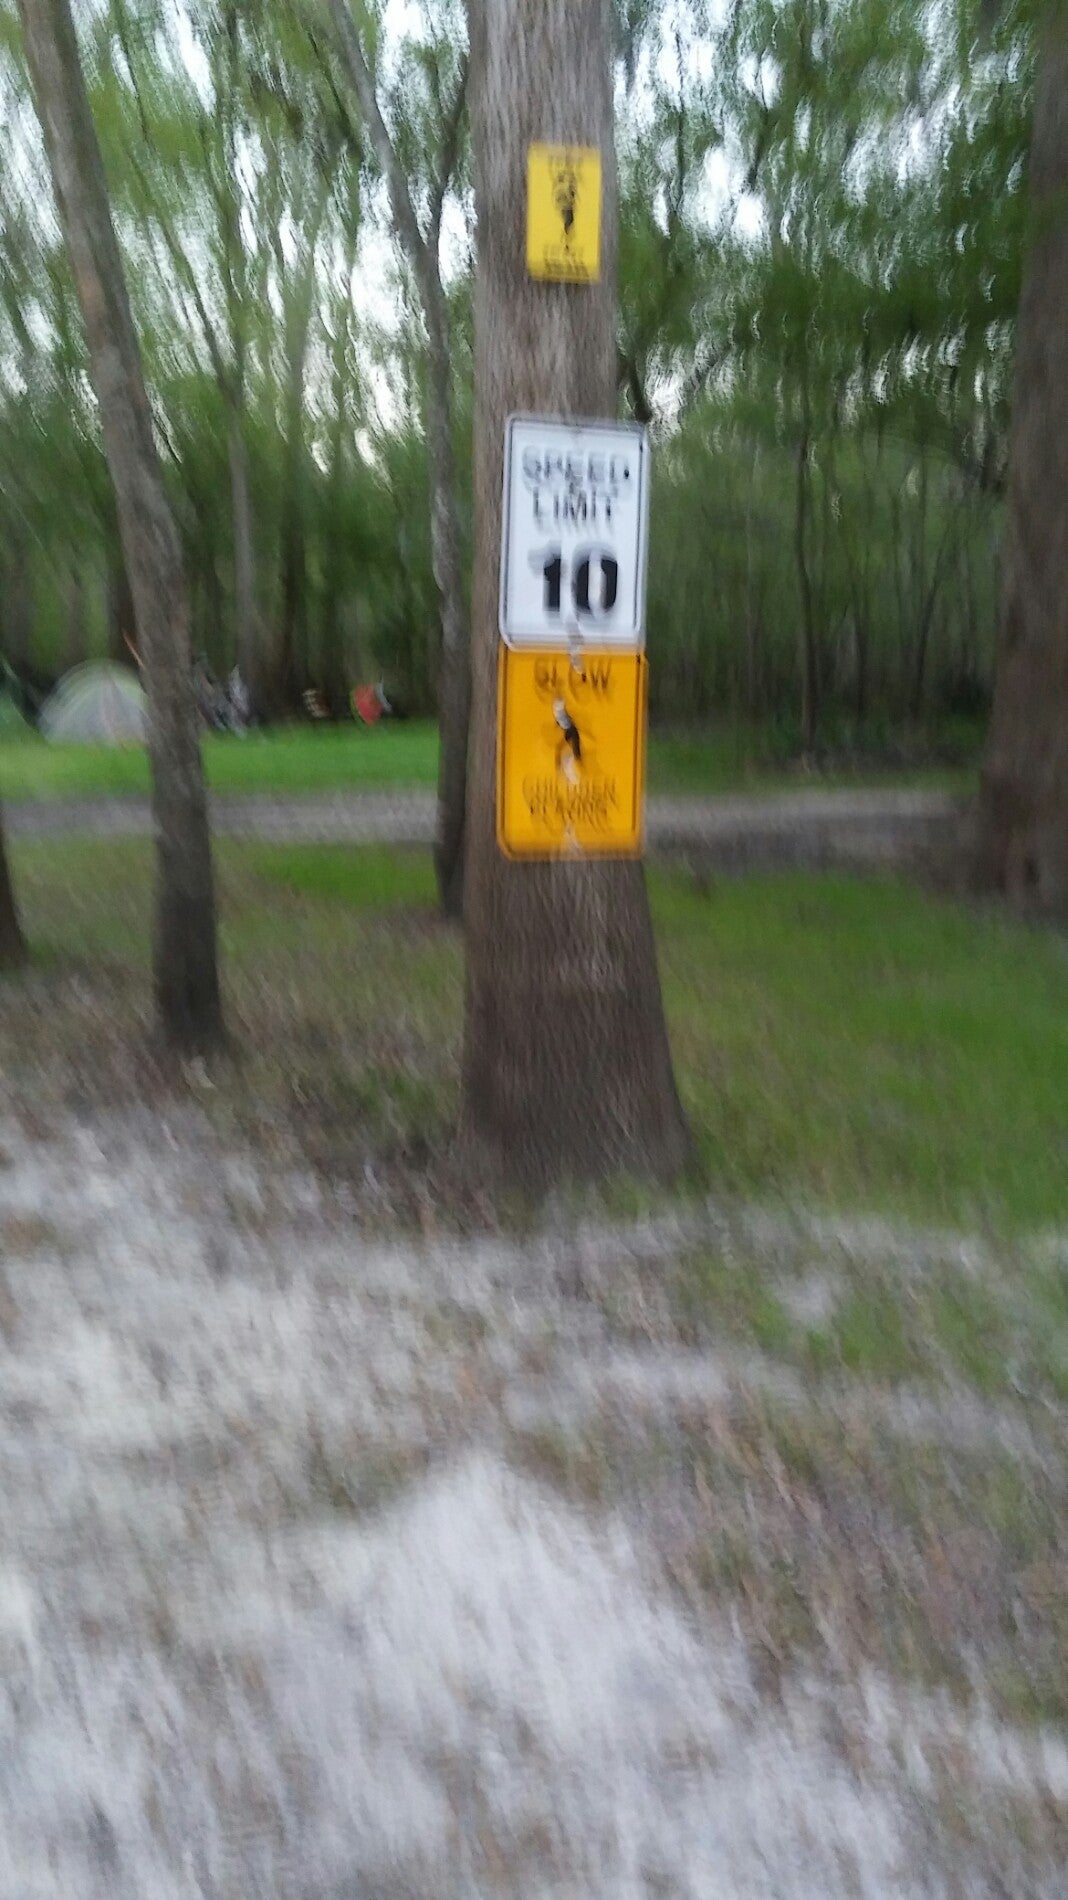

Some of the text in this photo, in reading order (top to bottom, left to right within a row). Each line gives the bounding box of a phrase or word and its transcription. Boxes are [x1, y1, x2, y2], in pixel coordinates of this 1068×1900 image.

[521, 446, 632, 489] SPEED
[532, 486, 619, 527] LIMIT
[528, 542, 619, 621] 10
